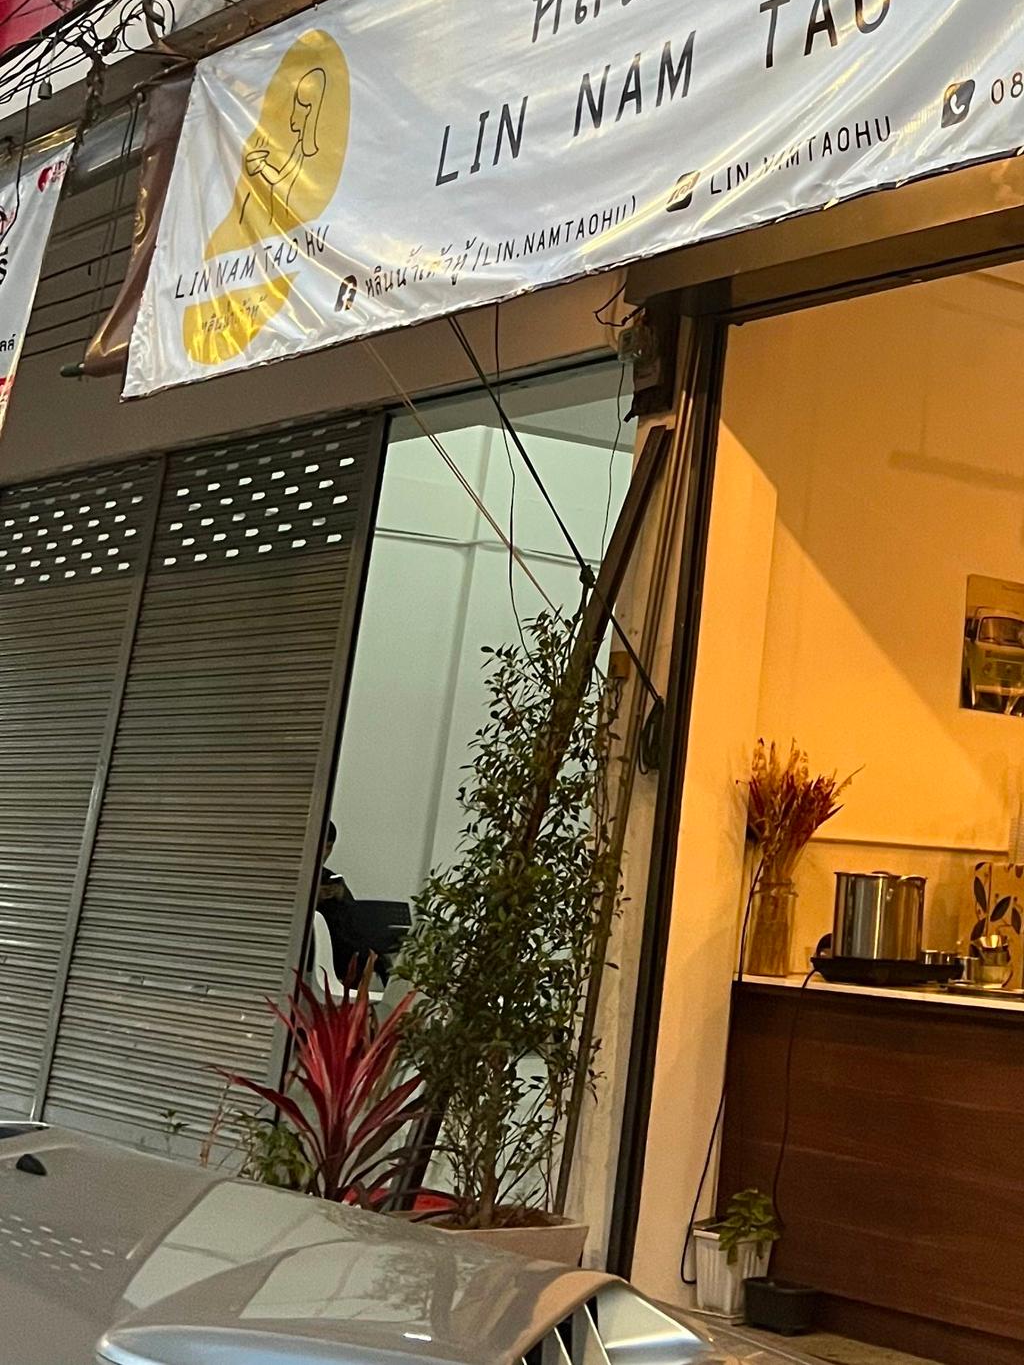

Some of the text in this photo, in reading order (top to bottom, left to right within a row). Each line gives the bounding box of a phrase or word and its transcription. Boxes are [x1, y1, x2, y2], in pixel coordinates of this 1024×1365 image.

[436, 95, 528, 186] LIN
[573, 30, 697, 137] NAM
[174, 224, 330, 300] LIN NAM TAO HU
